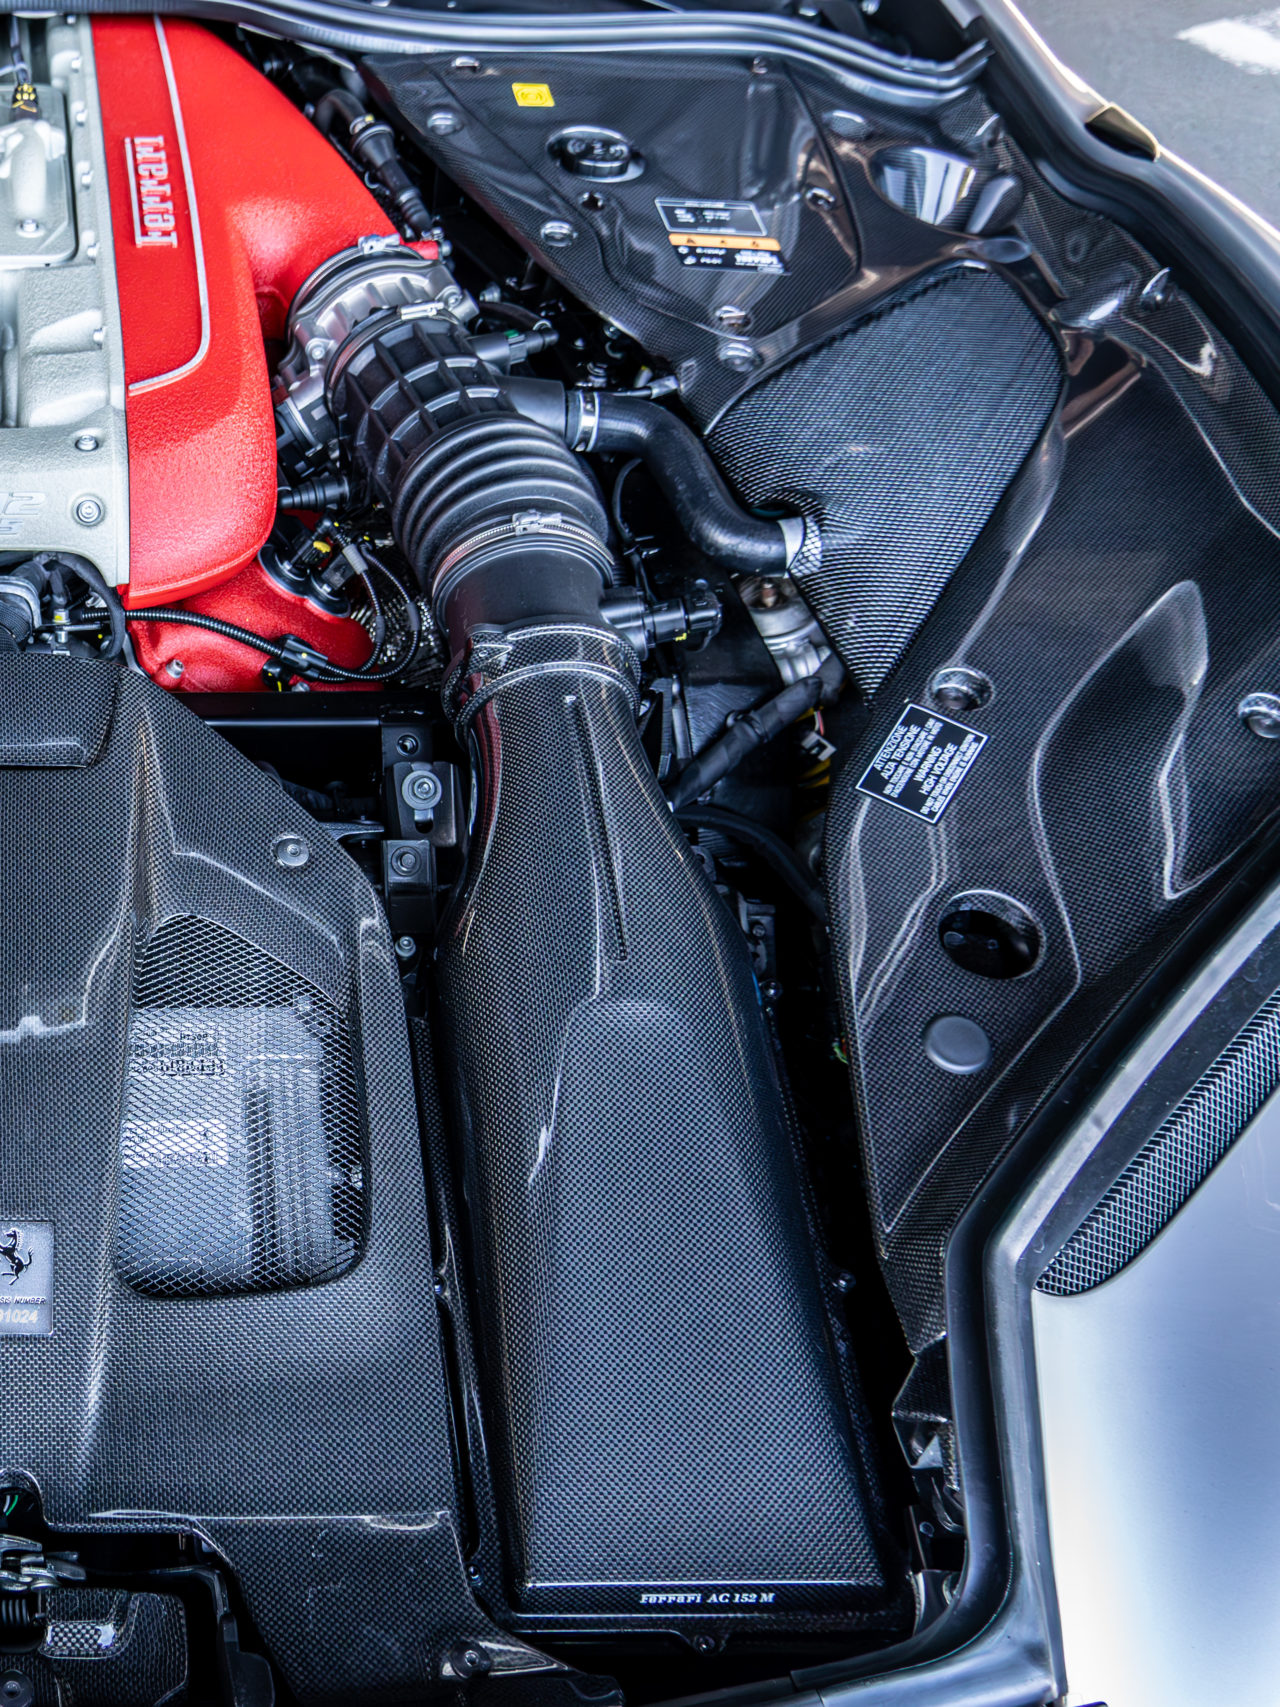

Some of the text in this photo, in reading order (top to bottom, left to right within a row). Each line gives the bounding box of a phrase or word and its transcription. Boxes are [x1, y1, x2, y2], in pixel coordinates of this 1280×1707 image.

[124, 135, 178, 248] Ferrari
[873, 724, 908, 771] ATTENZIONE
[880, 724, 921, 780] ALTA TENSIONE
[913, 746, 943, 782] WARNING
[918, 743, 958, 795] HIGH VOLTAGE
[14, 1295, 47, 1305] NUMBER
[639, 1593, 776, 1604] Ferrari AC 152 M
